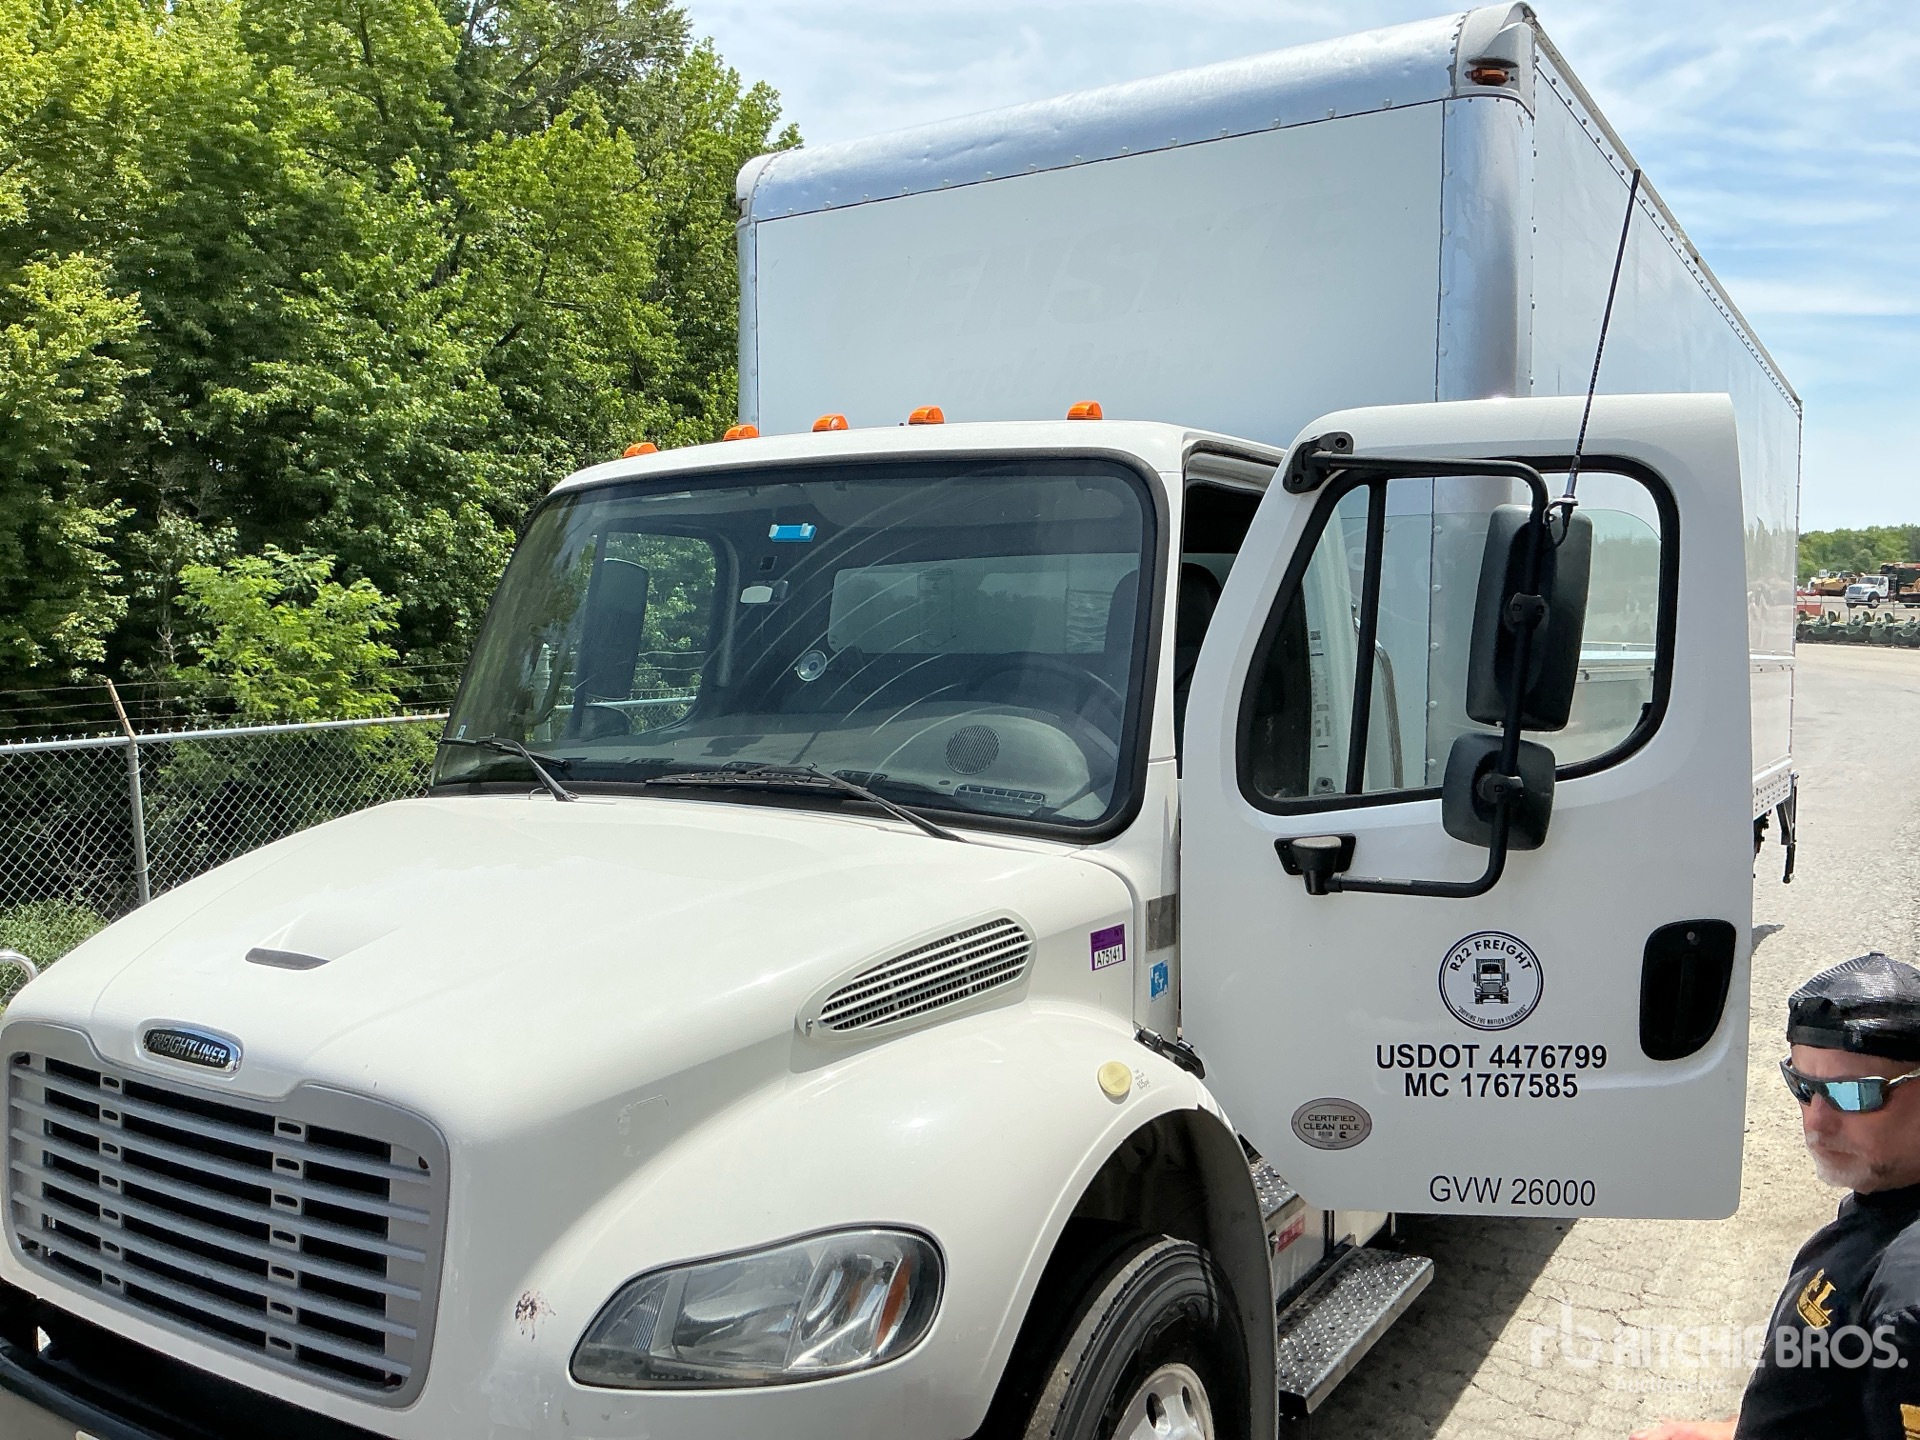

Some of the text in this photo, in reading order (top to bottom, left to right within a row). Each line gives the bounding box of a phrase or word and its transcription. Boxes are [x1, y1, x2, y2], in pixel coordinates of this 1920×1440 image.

[1096, 945, 1120, 967] A75141
[1449, 939, 1532, 971] R22 FREIGHT
[1487, 1017, 1505, 1025] NATION
[149, 1032, 228, 1064] FREIGHTLINER
[1376, 1044, 1607, 1069] USDOT 4476799
[1404, 1072, 1578, 1098] MC 1767585
[1307, 1114, 1356, 1122] CERTIFIED
[1339, 1123, 1360, 1131] IDLE
[1429, 1175, 1596, 1206] GVW 26000
